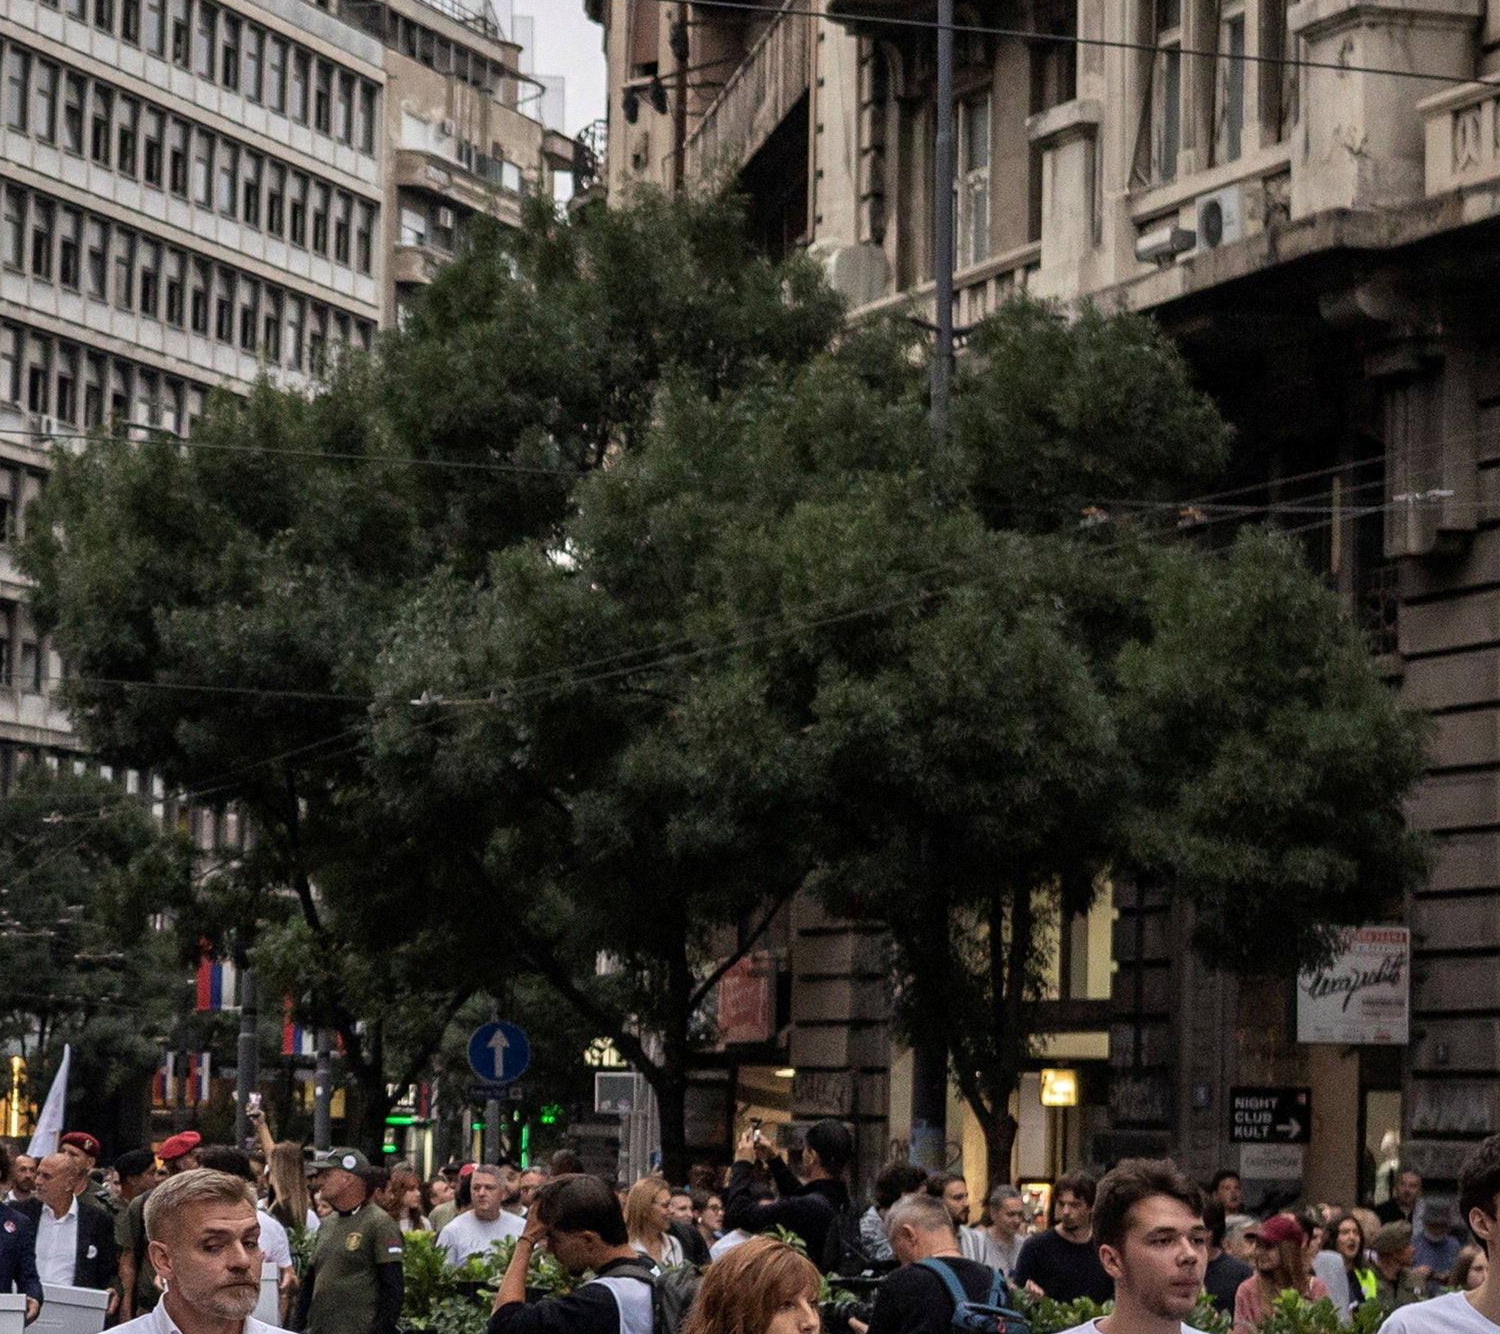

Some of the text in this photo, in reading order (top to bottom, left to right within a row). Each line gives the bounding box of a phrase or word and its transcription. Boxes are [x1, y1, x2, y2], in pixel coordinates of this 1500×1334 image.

[1234, 1097, 1279, 1110] NIGHT
[1234, 1110, 1273, 1124] CLUB
[1234, 1124, 1270, 1138] KULT
